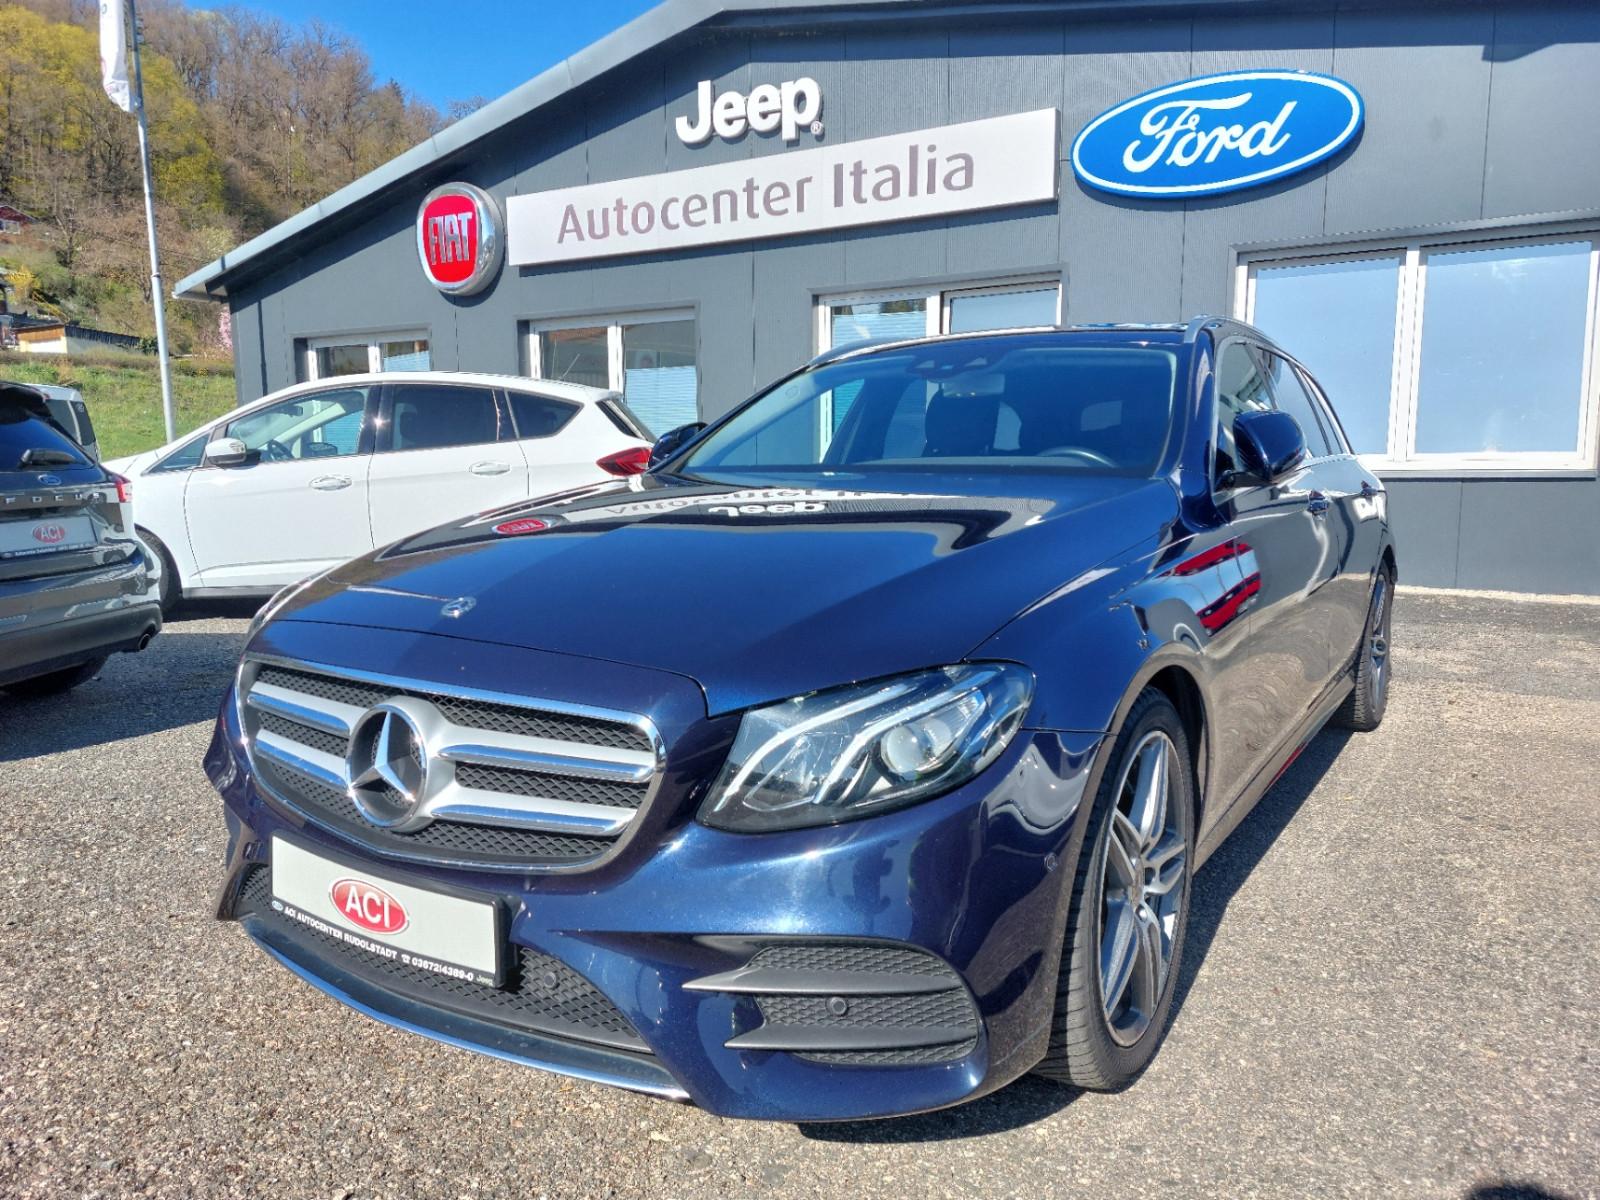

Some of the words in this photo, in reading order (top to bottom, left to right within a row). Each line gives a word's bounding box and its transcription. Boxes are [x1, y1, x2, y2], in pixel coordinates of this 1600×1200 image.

[675, 77, 822, 144] Jeep
[1122, 92, 1298, 173] Ford
[557, 175, 813, 244] Autocenter
[832, 143, 975, 208] Italia
[427, 211, 473, 266] FIAT
[41, 526, 61, 539] ACI
[284, 906, 296, 919] ACI
[297, 912, 343, 940] AUTOCENTER
[344, 933, 398, 959] RUDOLSTADT
[345, 885, 391, 928] ACI
